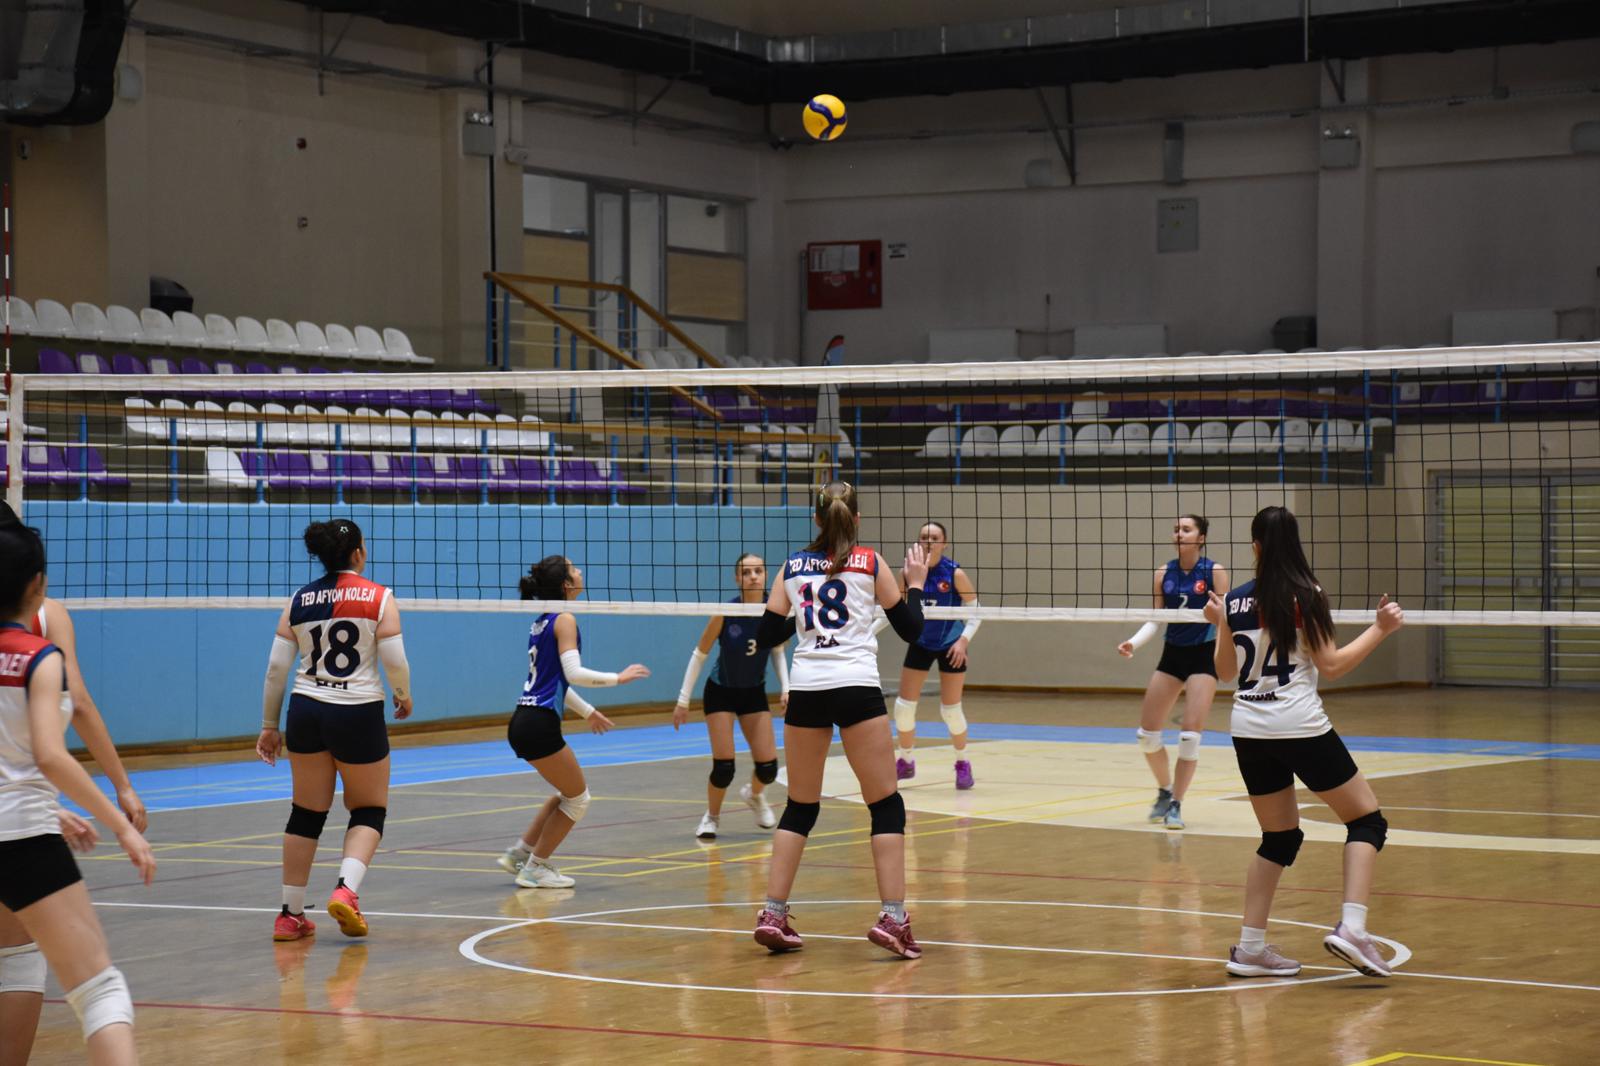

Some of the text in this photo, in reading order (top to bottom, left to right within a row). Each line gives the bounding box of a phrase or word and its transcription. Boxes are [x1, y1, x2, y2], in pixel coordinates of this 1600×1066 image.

[301, 587, 376, 607] TED AFYON KOLEJİ
[798, 579, 849, 632] 18
[305, 620, 361, 678] 18
[745, 638, 757, 657] 3
[1232, 633, 1298, 691] 24
